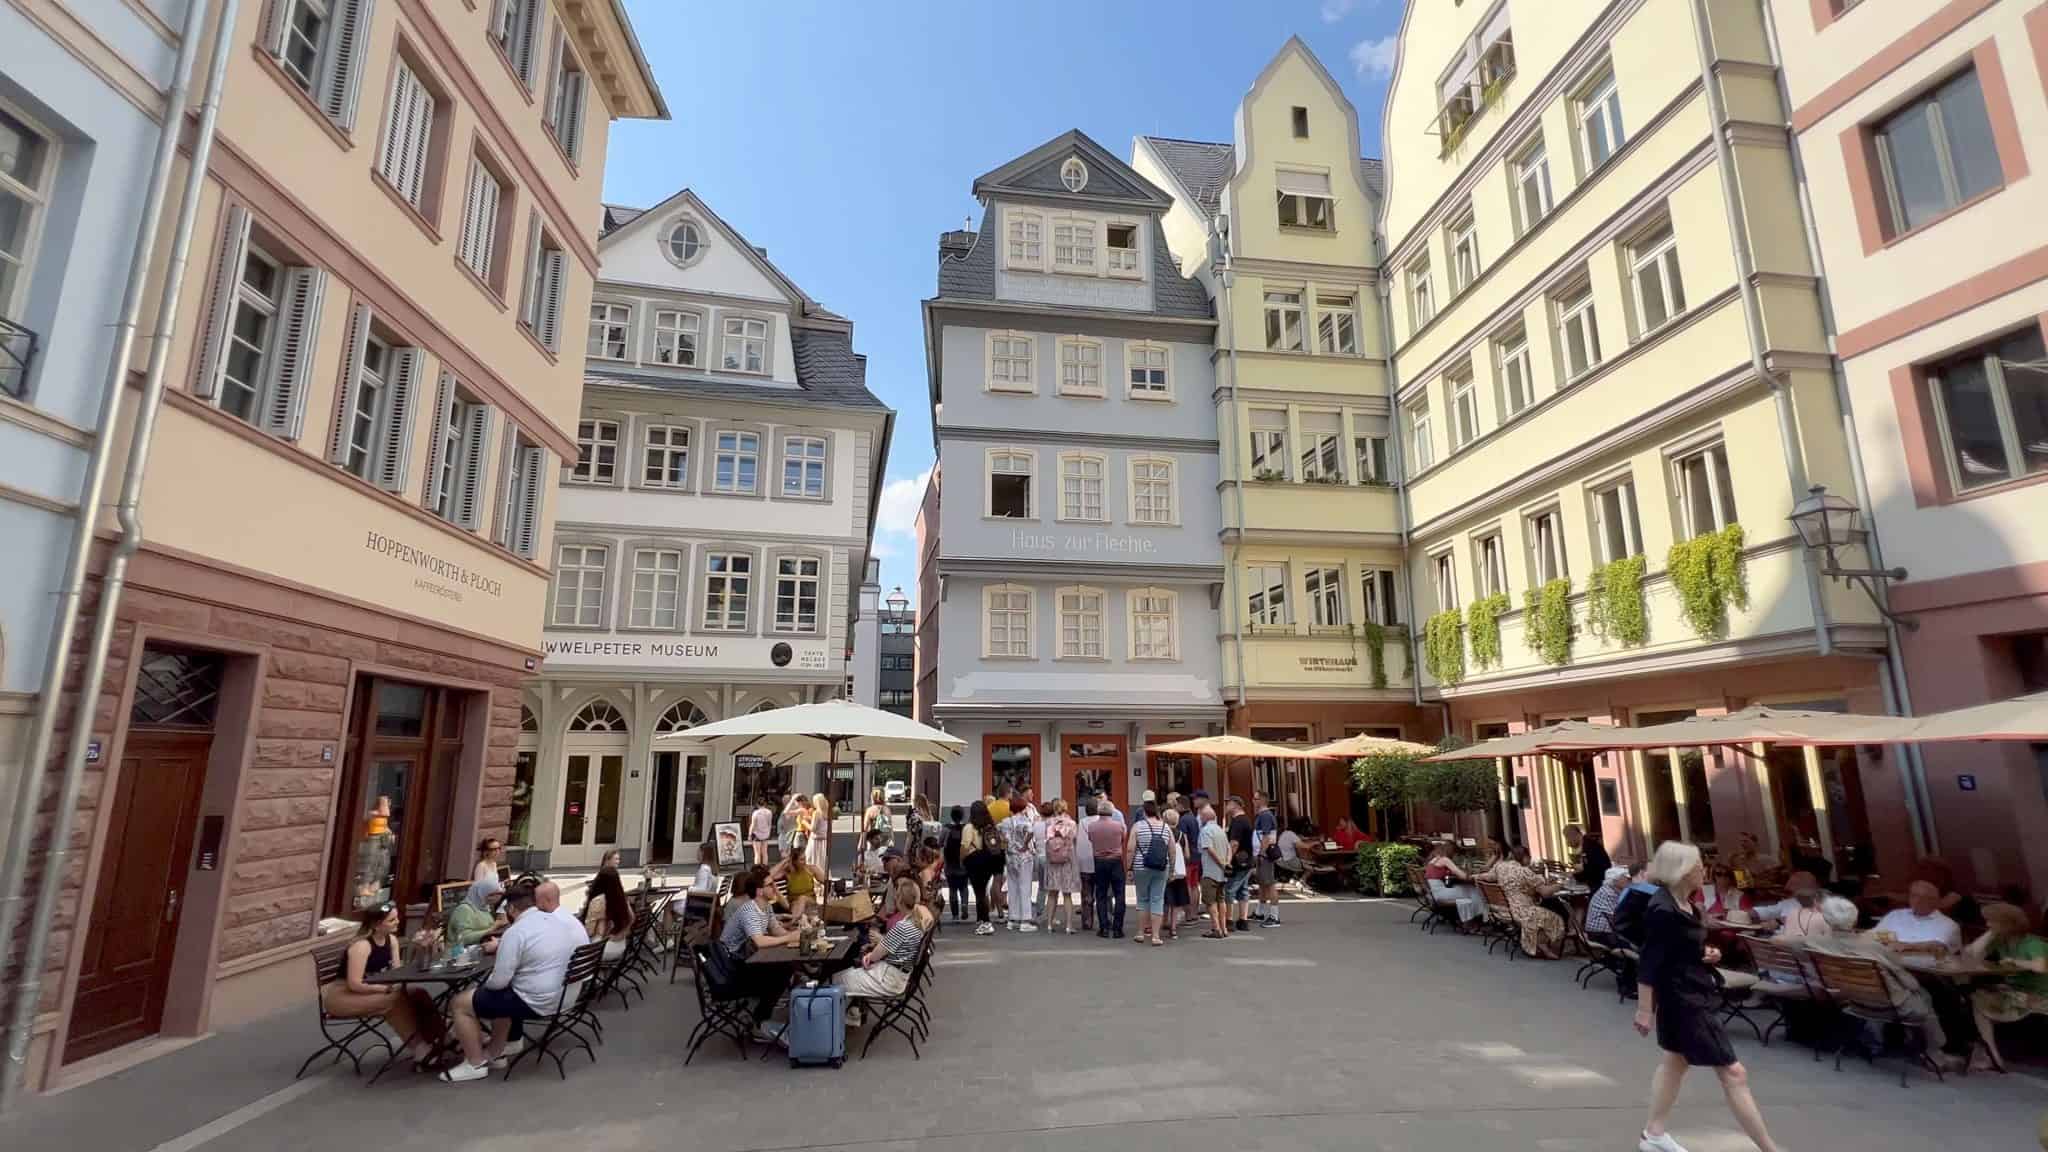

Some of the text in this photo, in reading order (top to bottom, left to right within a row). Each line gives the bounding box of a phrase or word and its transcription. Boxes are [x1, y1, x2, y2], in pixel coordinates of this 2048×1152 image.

[1010, 527, 1055, 550] Haus
[1064, 535, 1091, 550] zur
[365, 531, 502, 597] HOPPENWORTH & PLOCH
[650, 643, 719, 657] MUSEUM
